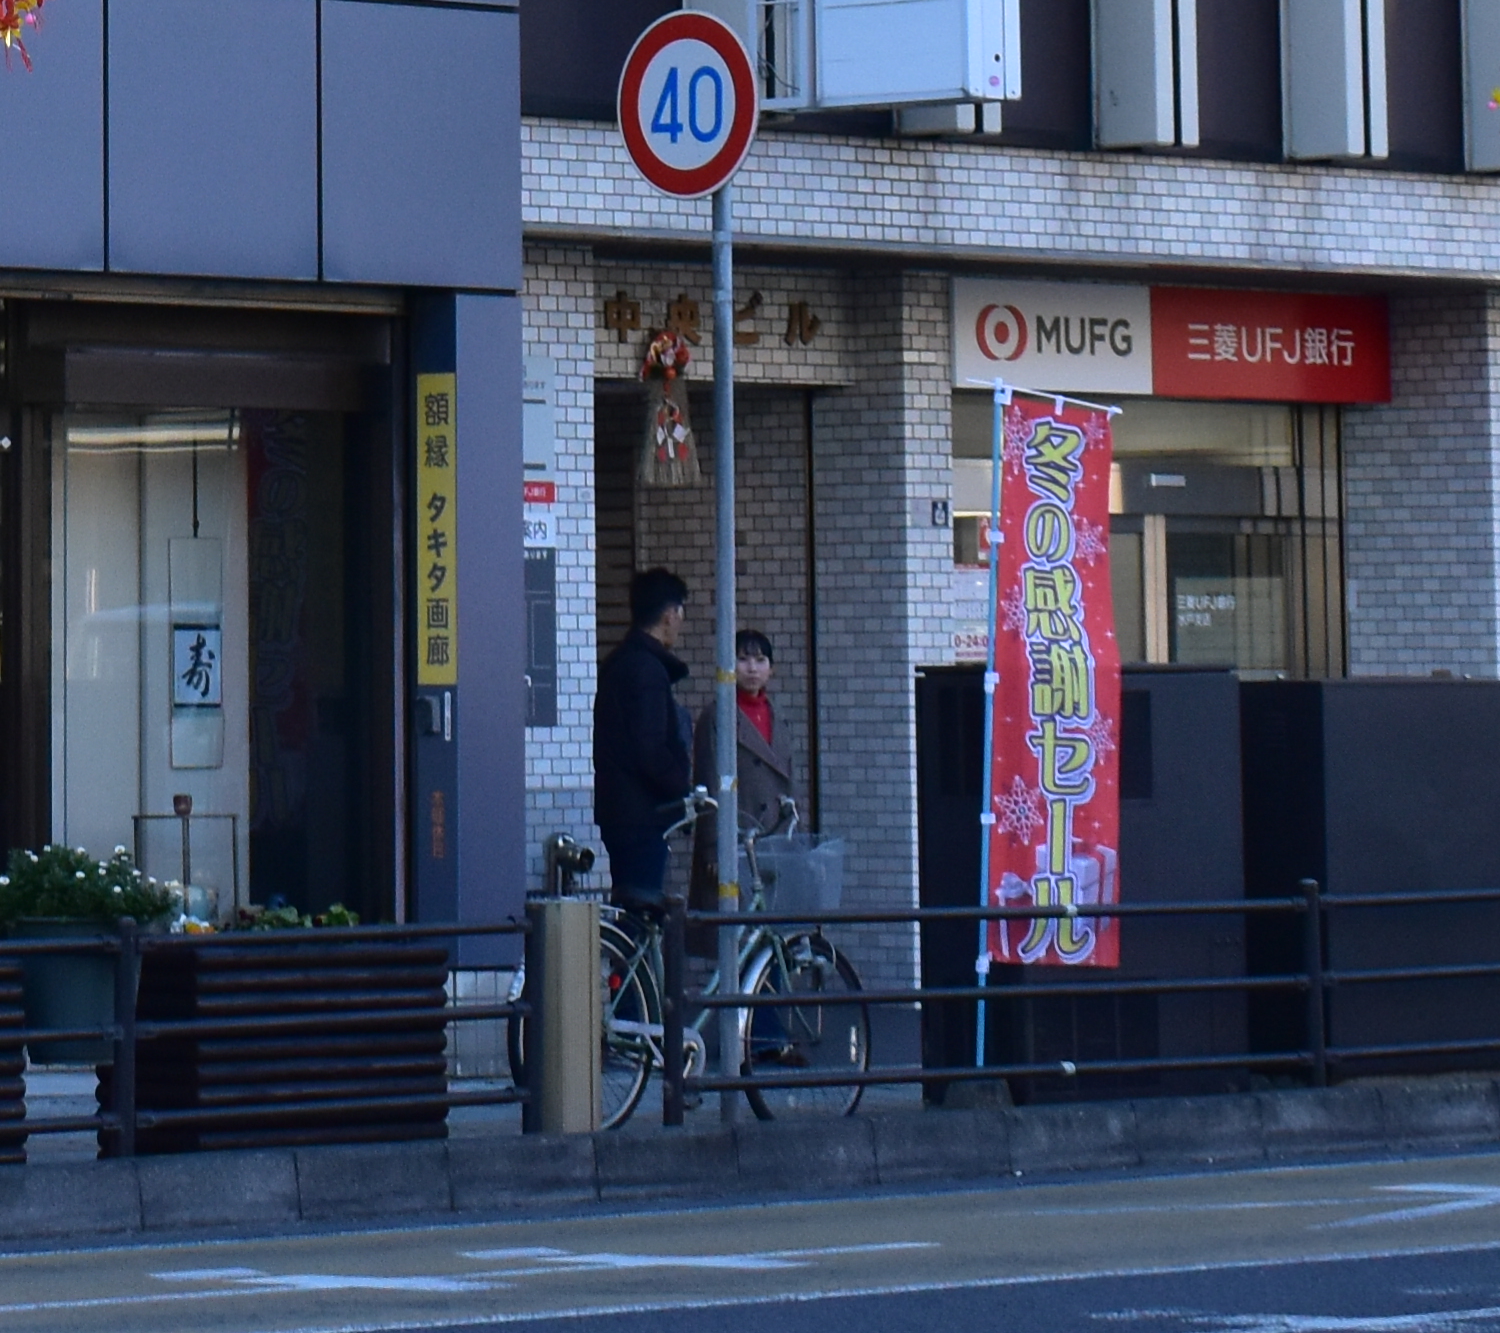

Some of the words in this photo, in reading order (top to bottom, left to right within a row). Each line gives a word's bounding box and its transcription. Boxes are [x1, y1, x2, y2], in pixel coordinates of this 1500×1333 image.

[651, 65, 723, 144] 40
[604, 290, 821, 347] 中央ビル
[1035, 315, 1133, 357] MUFG
[1187, 323, 1356, 366] 三菱UFJ銀行
[424, 392, 449, 468] 額縁
[426, 492, 450, 667] タキタ画廊
[1018, 417, 1096, 965] 冬の感謝セール
